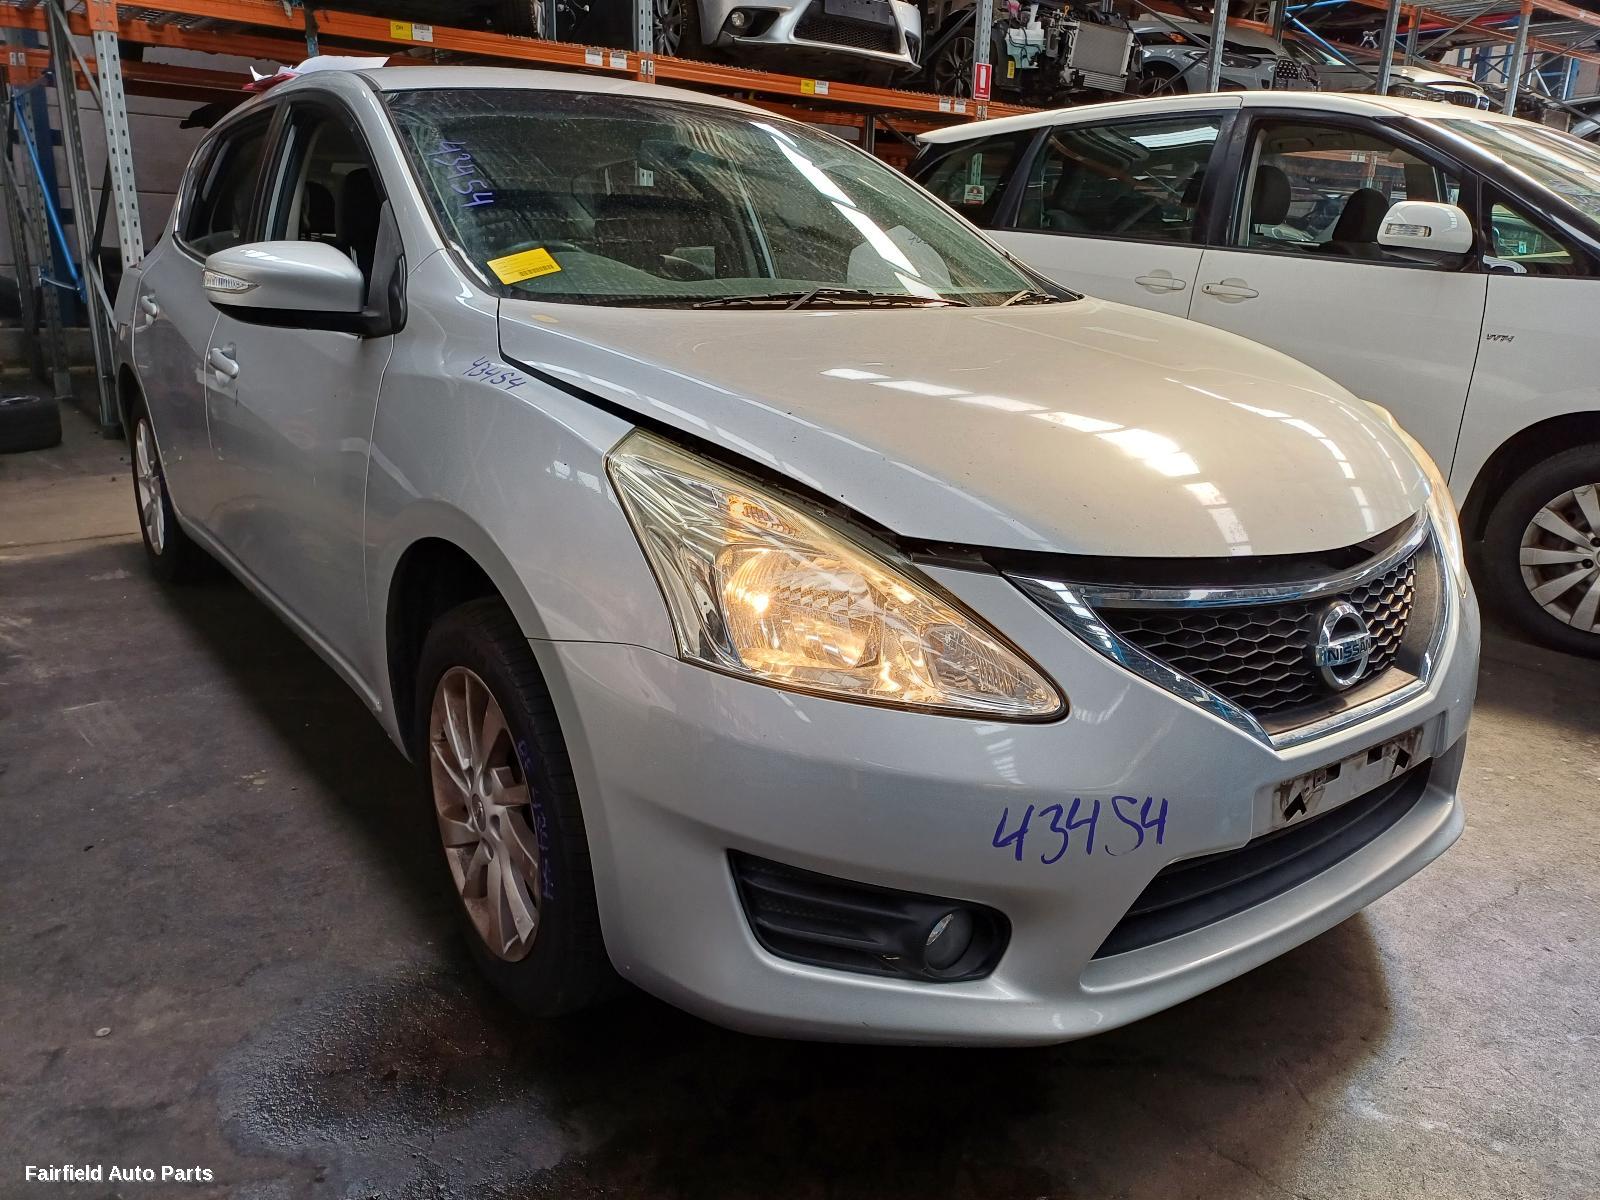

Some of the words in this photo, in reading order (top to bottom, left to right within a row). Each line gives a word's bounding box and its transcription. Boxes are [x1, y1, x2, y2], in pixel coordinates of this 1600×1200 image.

[462, 354, 527, 391] 43454
[1326, 639, 1371, 662] NISSAN
[992, 795, 1168, 864] 43454
